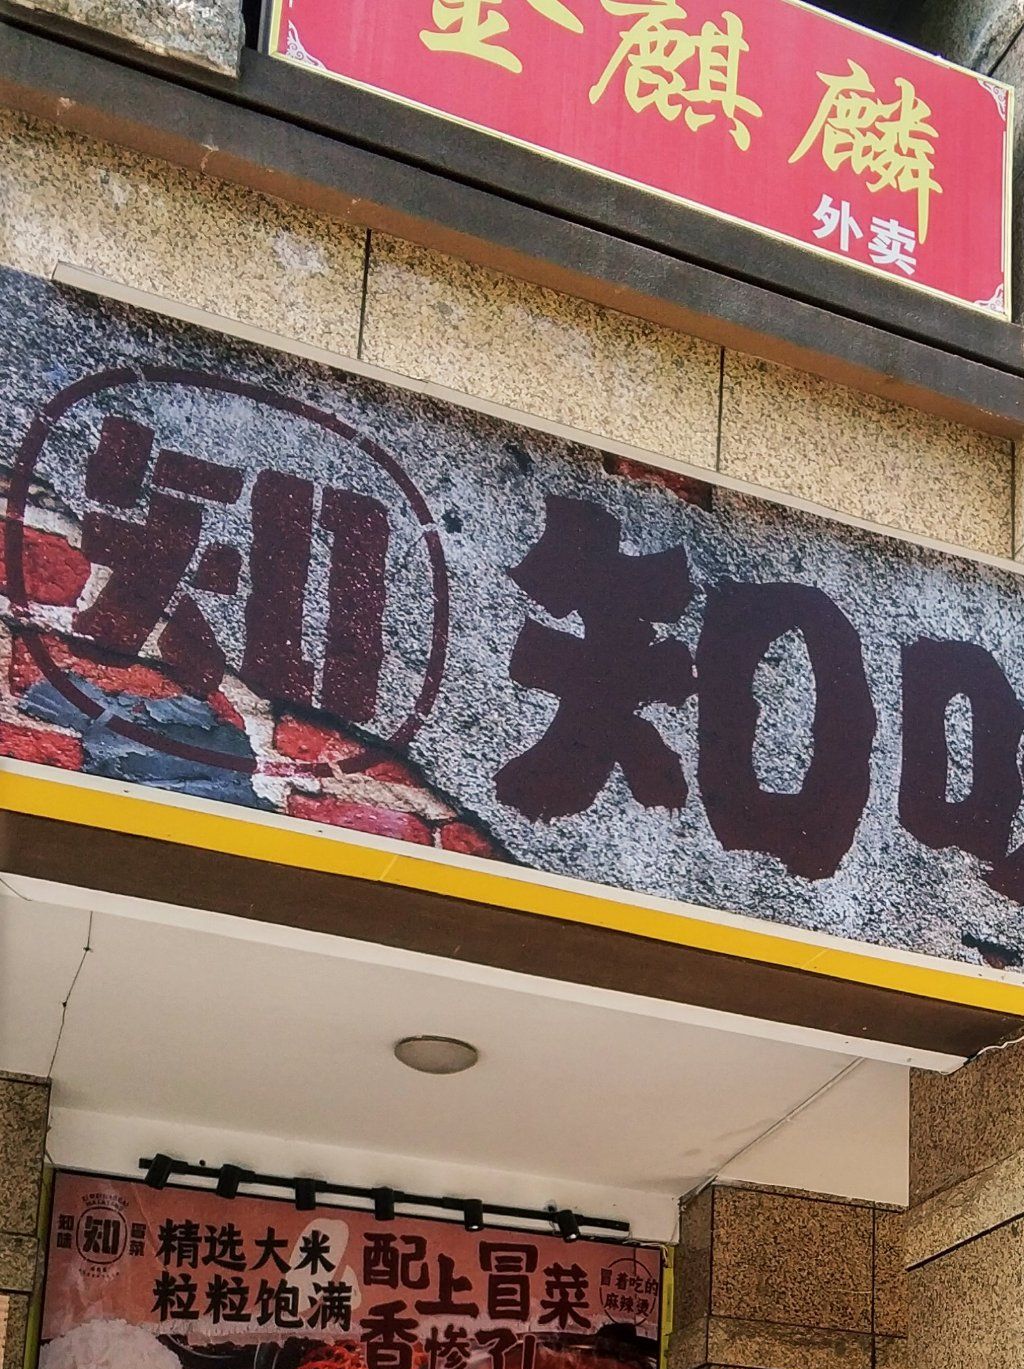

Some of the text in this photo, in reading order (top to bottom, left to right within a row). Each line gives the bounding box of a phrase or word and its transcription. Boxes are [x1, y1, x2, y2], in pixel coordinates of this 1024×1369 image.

[813, 194, 917, 275] 外卖
[155, 1217, 337, 1276] 精选大米
[362, 1231, 592, 1330] 配上冒菜
[151, 1270, 353, 1333] 粒粒饱满
